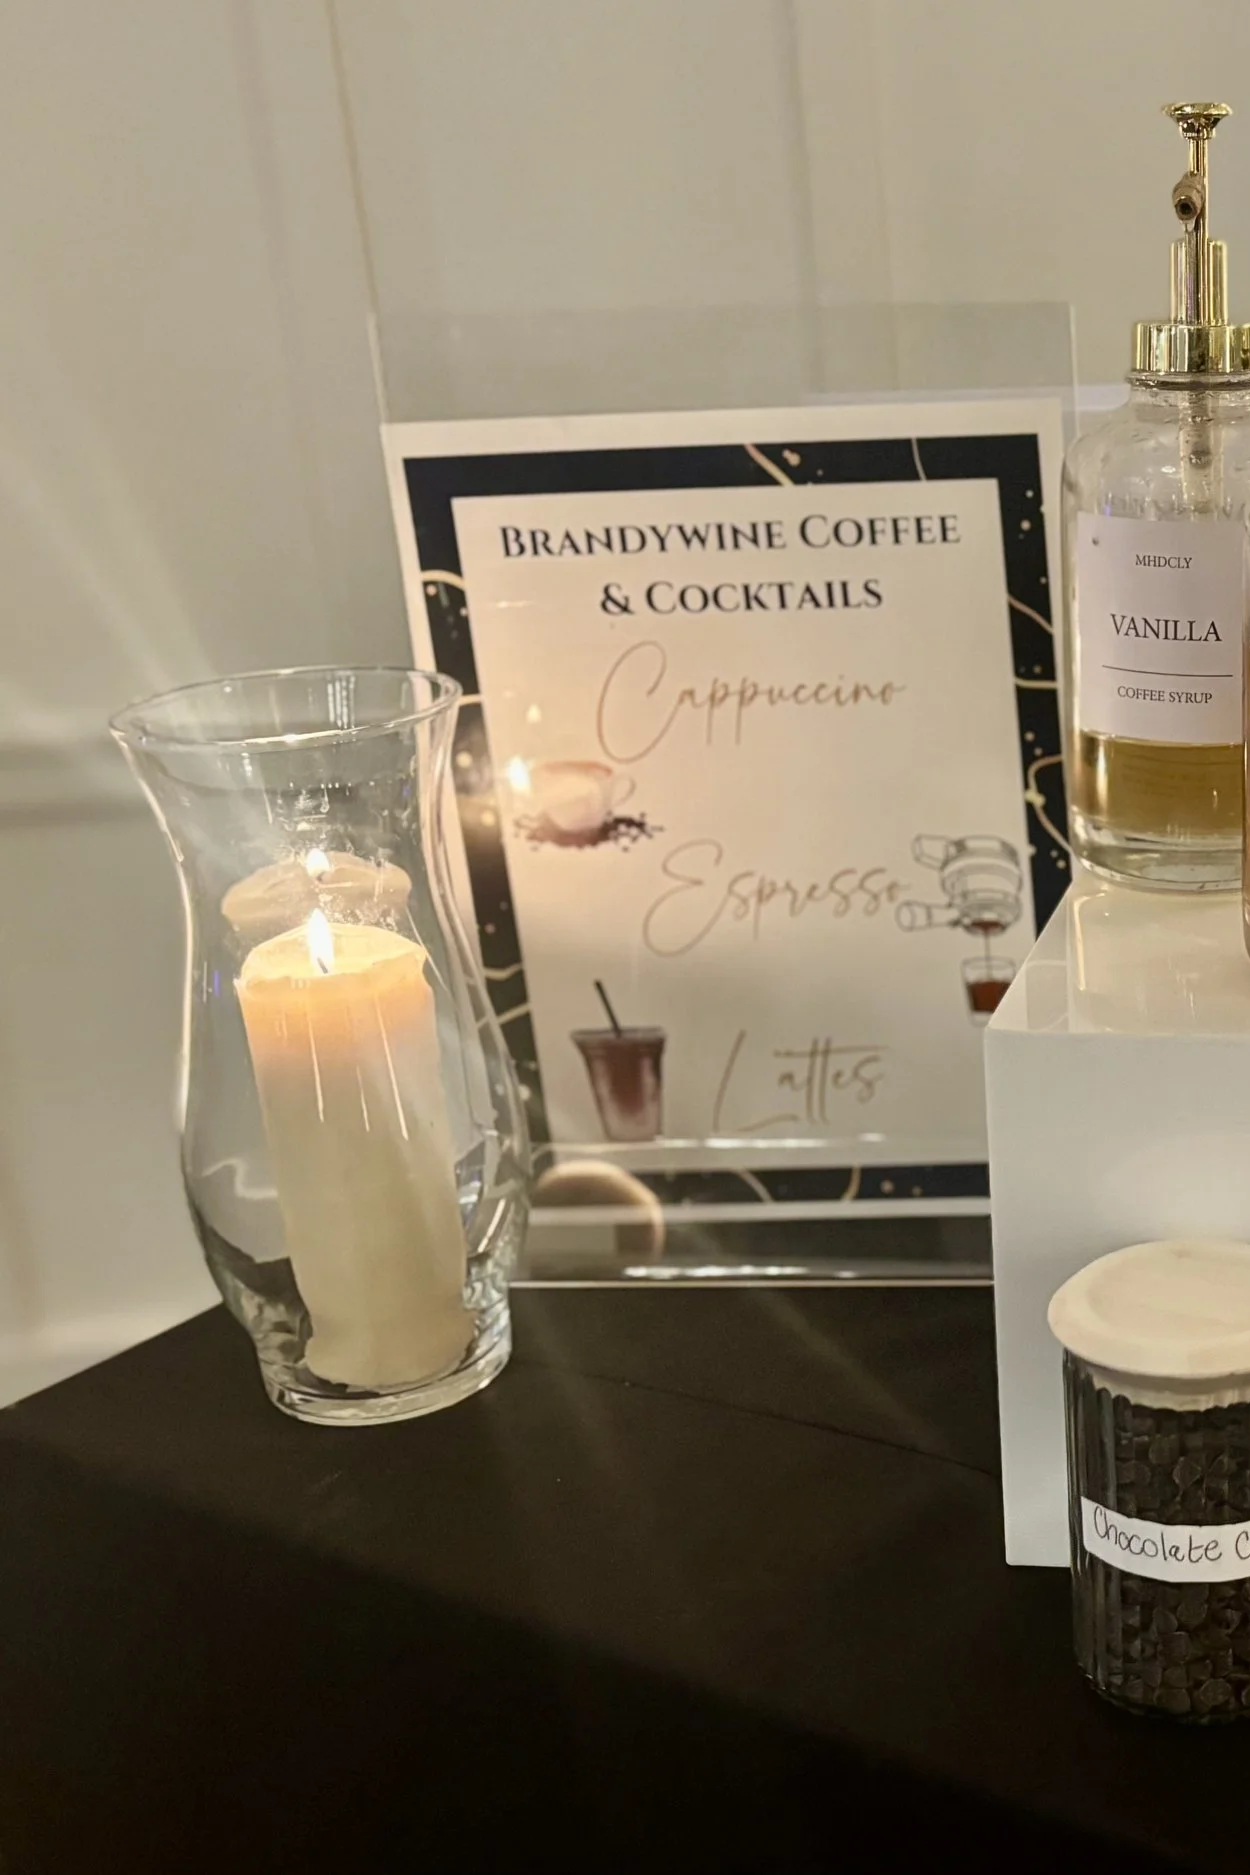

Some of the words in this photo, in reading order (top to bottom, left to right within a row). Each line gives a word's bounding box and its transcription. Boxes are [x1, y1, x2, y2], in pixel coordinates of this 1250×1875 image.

[499, 521, 788, 559] BRANDYWINE
[799, 514, 962, 550] COFFEE
[1134, 553, 1193, 570] MHDCLY
[599, 582, 636, 616] &
[645, 578, 884, 613] COCKTAILS
[1109, 613, 1223, 642] VANILLA
[595, 640, 907, 764] Cappuccino
[1116, 685, 1165, 702] COFFEE
[1168, 690, 1213, 704] SYRUP
[642, 837, 912, 957] Espresso
[712, 1028, 890, 1134] Lattes
[1093, 1505, 1223, 1564] Chocolate
